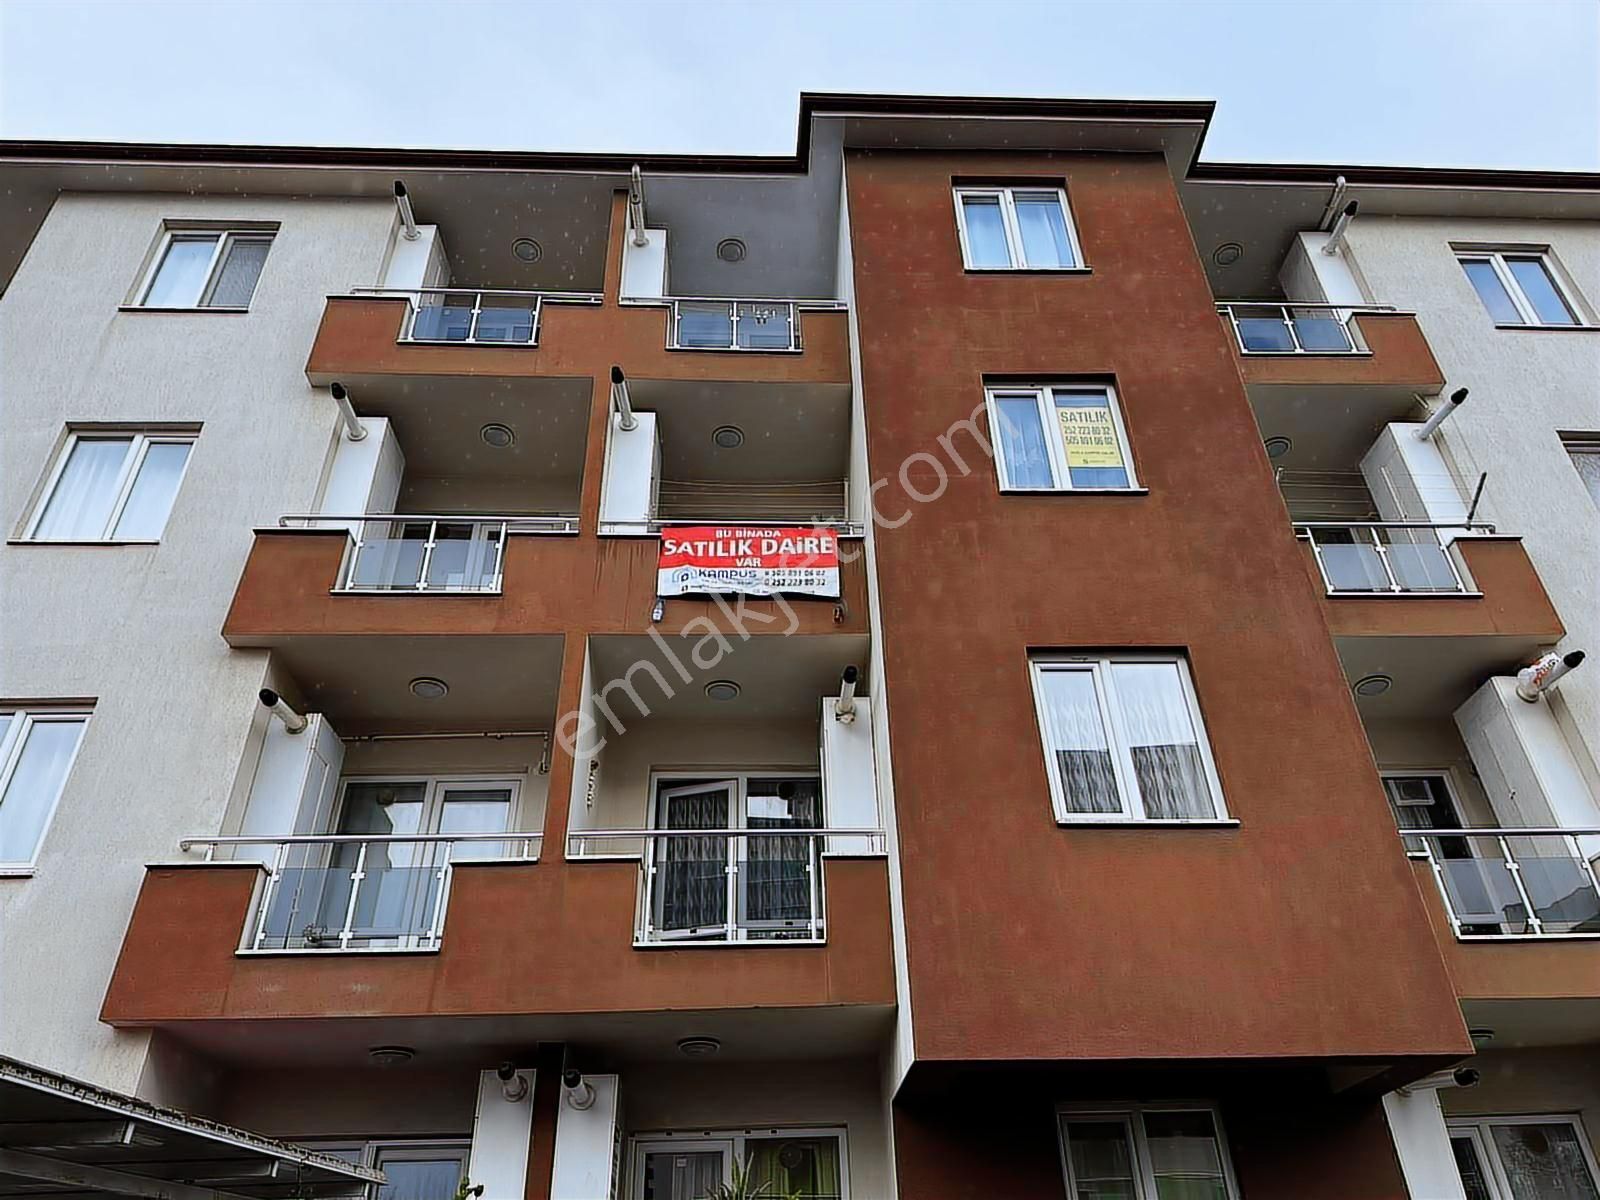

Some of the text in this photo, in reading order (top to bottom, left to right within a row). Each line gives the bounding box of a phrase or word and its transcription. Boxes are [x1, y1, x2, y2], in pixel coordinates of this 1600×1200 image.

[1060, 411, 1108, 423] SATILIK
[715, 529, 731, 538] BU
[663, 539, 753, 557] SATILIK
[735, 557, 762, 567] VAR
